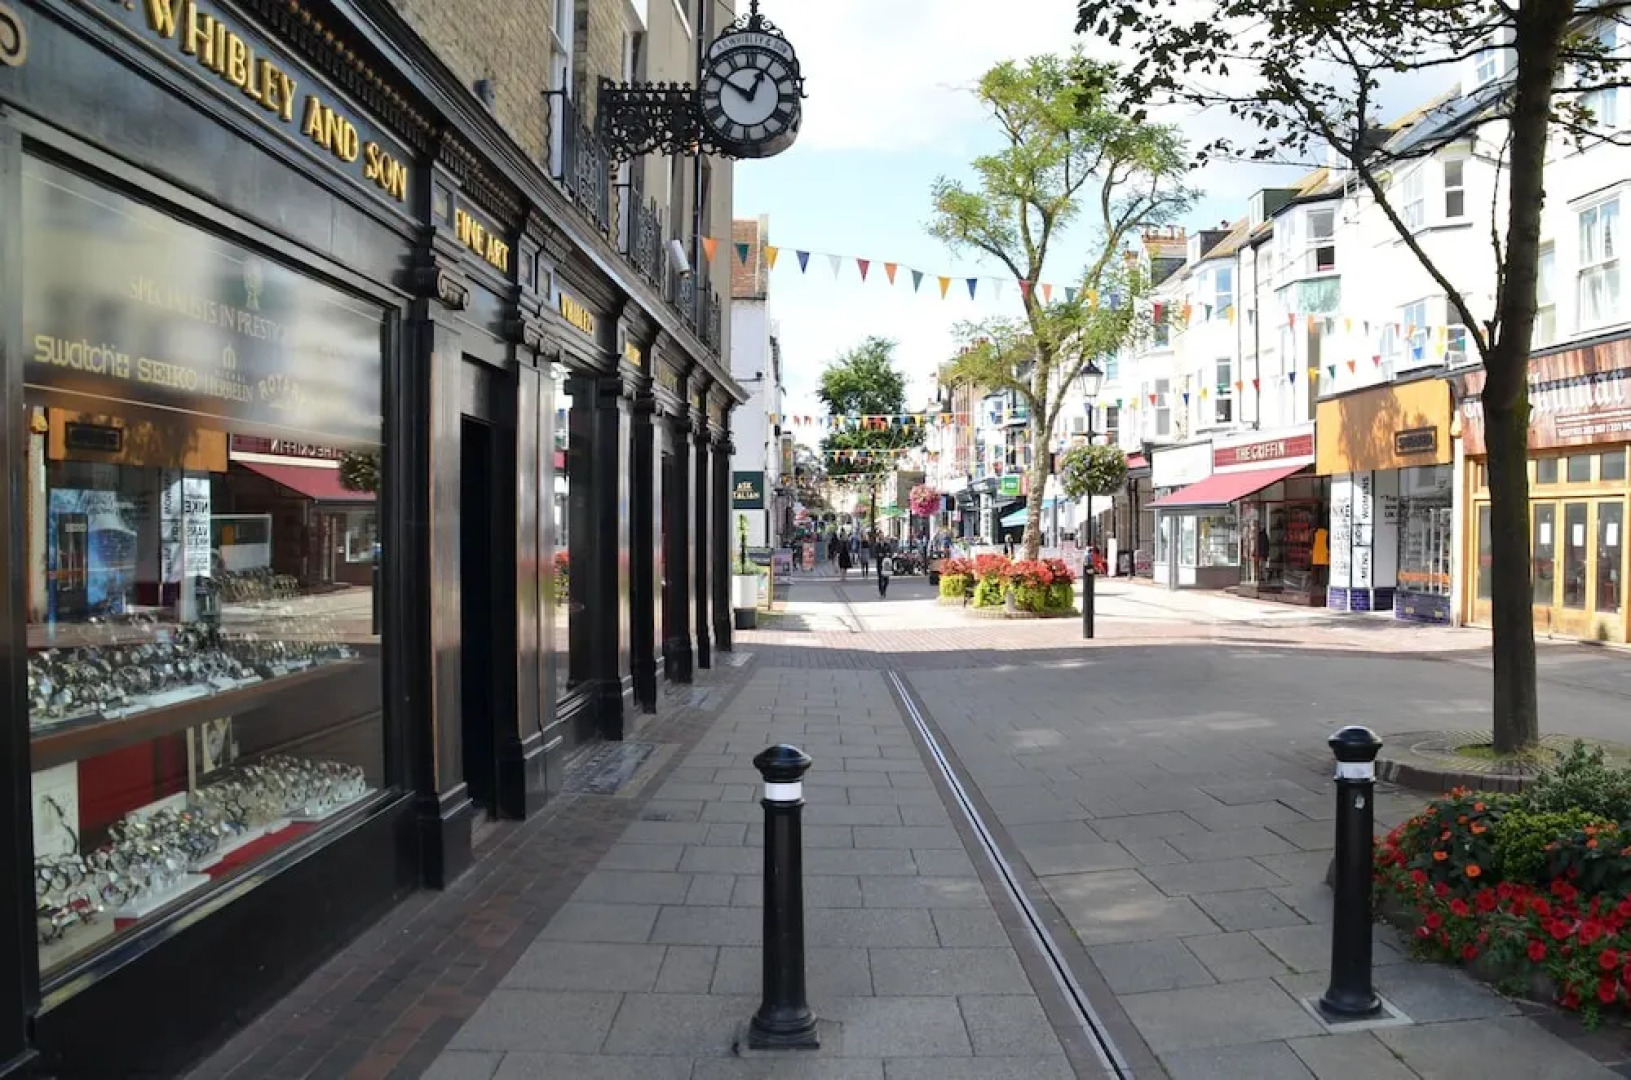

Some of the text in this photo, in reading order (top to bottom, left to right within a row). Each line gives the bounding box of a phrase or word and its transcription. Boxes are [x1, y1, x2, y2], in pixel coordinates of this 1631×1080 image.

[143, 0, 408, 202] WHIBLEY AND SON
[455, 208, 510, 274] FINE ART
[34, 334, 116, 377] swatch
[137, 356, 199, 391] SEIKO
[1235, 440, 1286, 461] THE GRIFFIN
[737, 482, 753, 490] ASK
